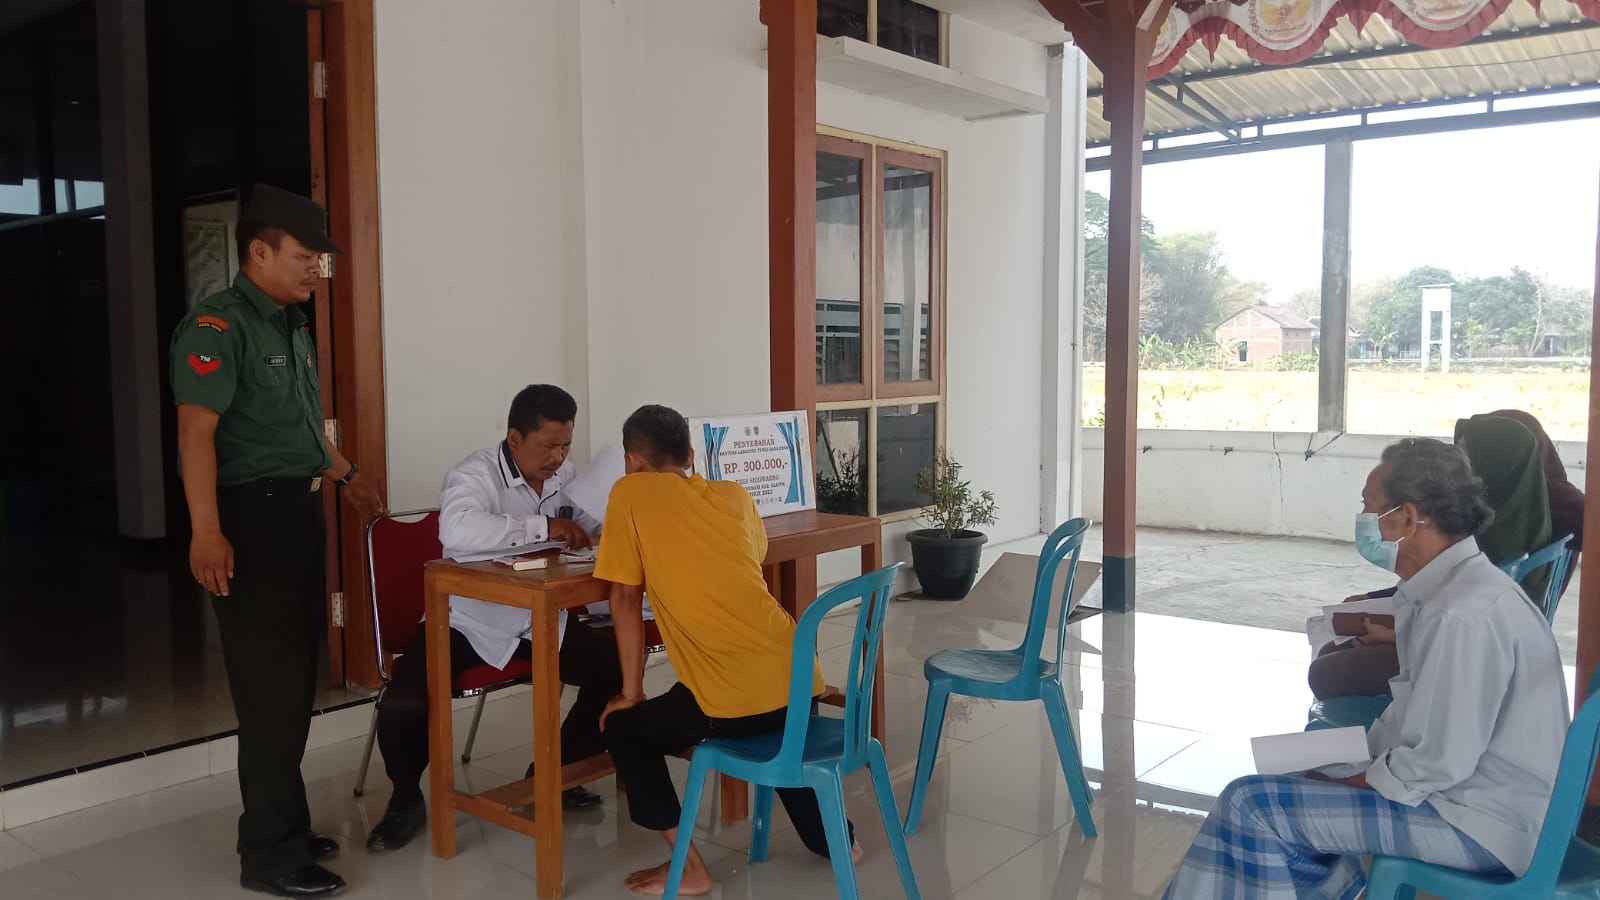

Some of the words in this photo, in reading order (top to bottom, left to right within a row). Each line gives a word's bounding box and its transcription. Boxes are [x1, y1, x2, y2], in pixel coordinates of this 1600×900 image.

[733, 438, 775, 449] PENYERAHAN
[723, 462, 741, 474] RP.
[743, 458, 788, 472] 300.000,-
